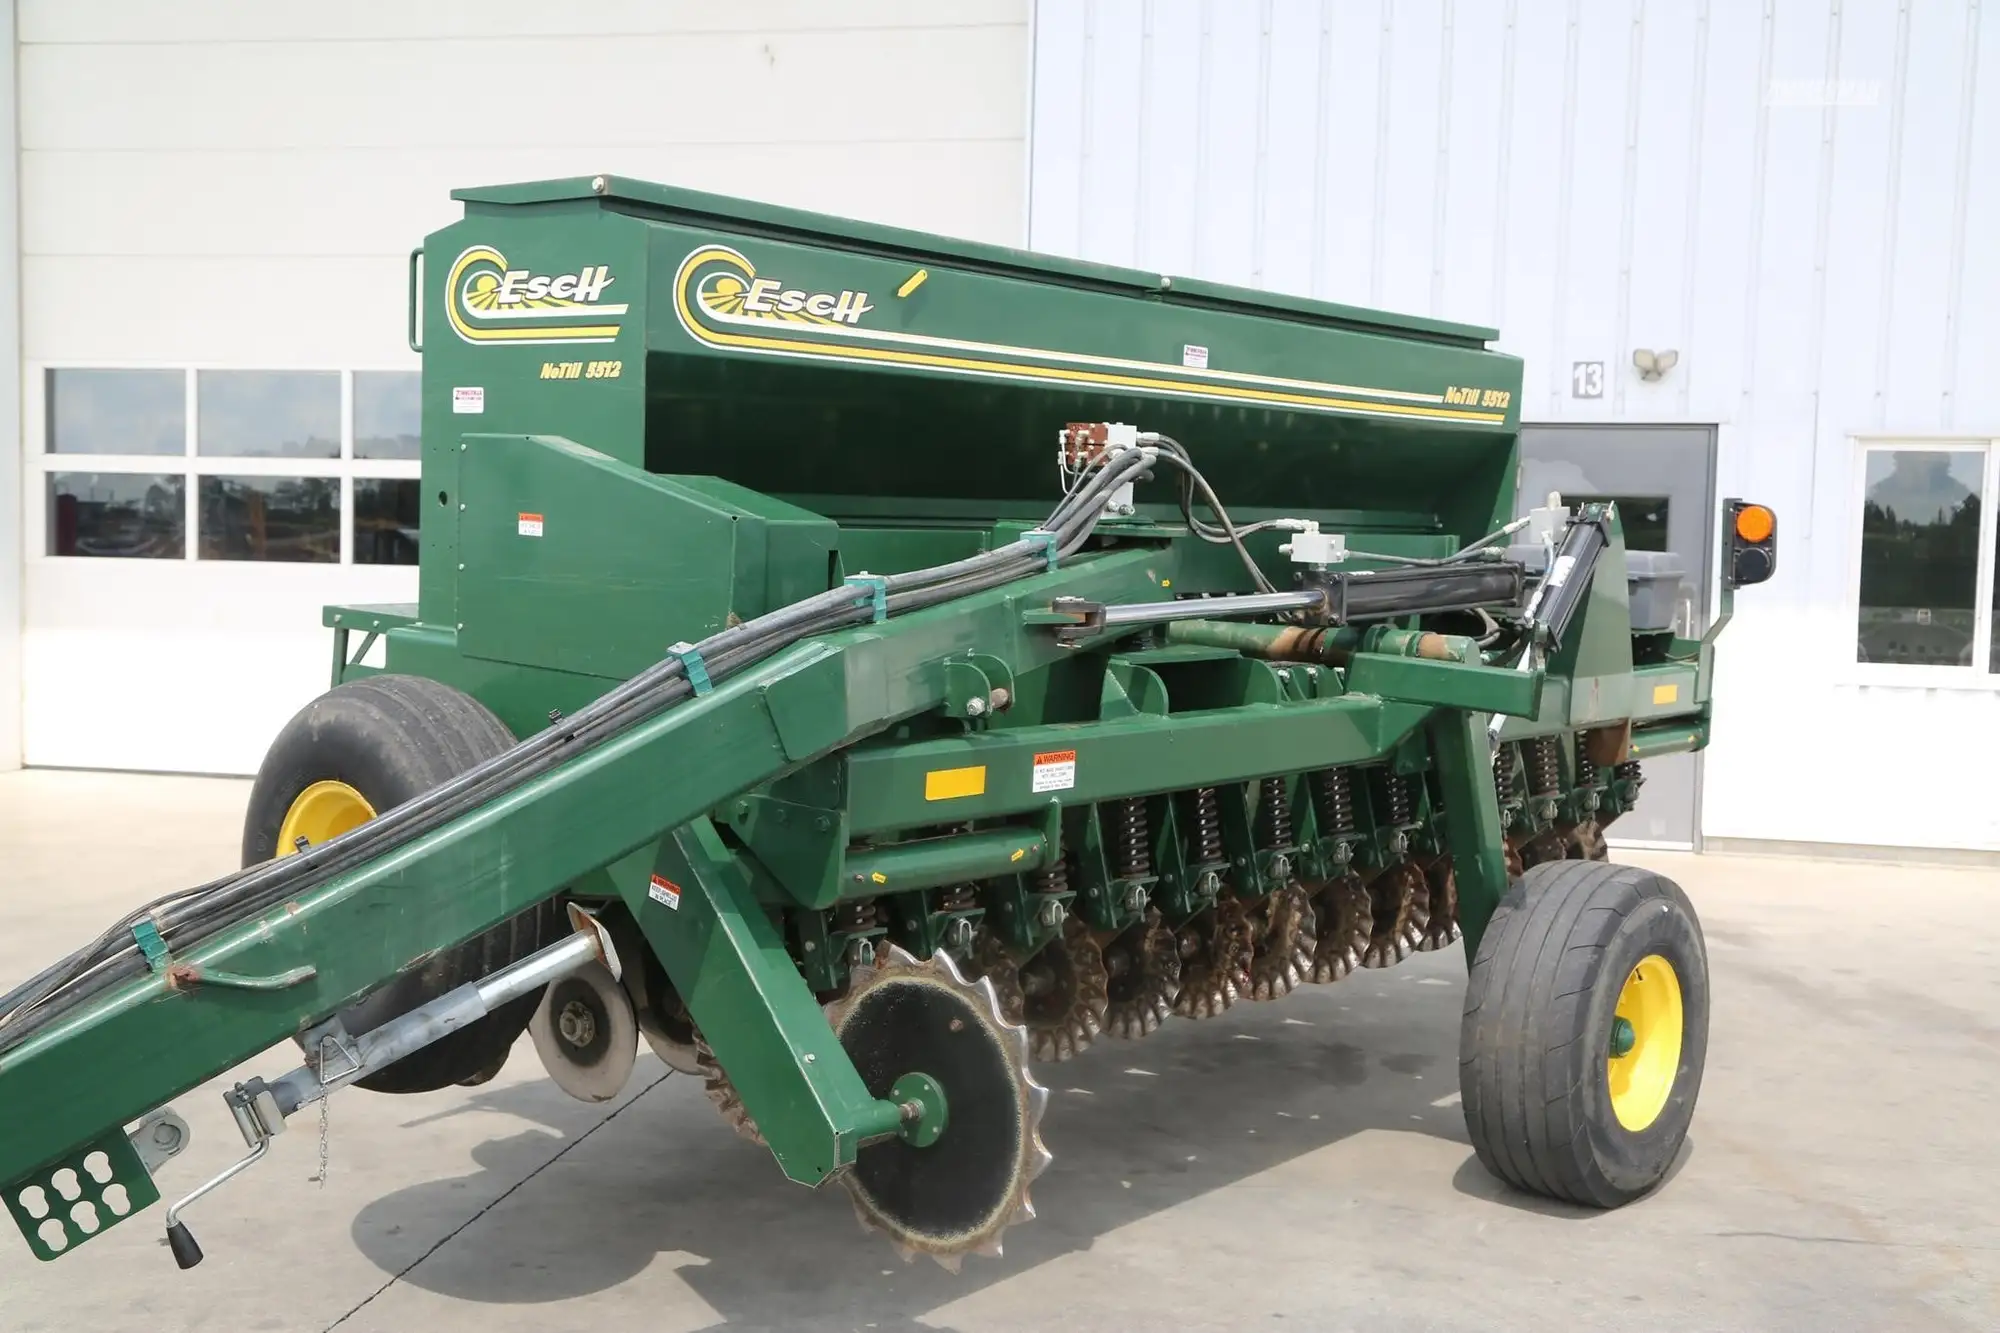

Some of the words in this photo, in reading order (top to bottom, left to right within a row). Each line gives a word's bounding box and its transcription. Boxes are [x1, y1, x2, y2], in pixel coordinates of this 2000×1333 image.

[540, 362, 583, 379] NoTill
[585, 361, 622, 379] 5512
[1574, 363, 1602, 395] 13
[1444, 386, 1481, 406] NoTill
[1043, 751, 1074, 764] WARNING
